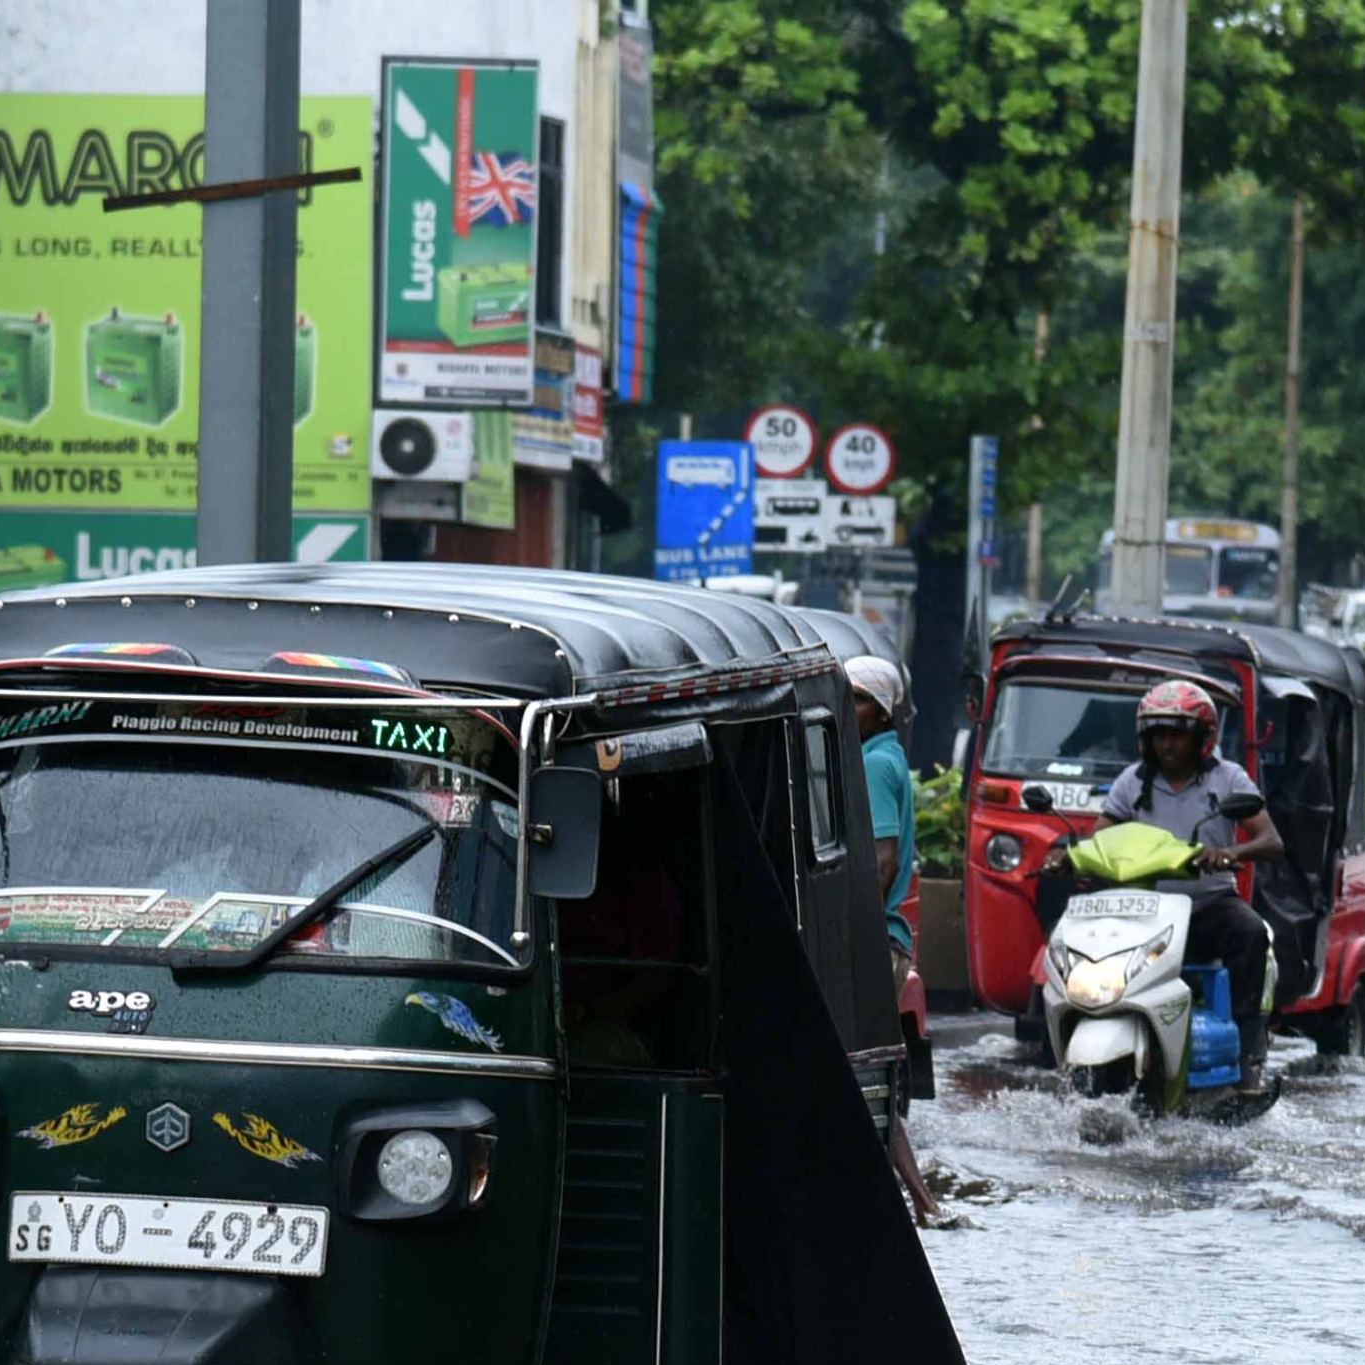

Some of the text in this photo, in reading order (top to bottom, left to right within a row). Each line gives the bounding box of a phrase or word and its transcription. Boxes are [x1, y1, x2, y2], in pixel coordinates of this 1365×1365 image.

[16, 238, 101, 260] LONG,
[112, 238, 202, 257] REALL
[401, 199, 436, 301] Lucas
[766, 418, 796, 437] 50
[846, 436, 876, 453] 40
[12, 468, 123, 493] MOTORS
[76, 532, 198, 580] Luca
[655, 545, 748, 564] BUS LANE
[112, 714, 359, 743] Piaggio Racing Development
[371, 719, 447, 753] TAXI
[69, 990, 150, 1012] ape
[16, 1224, 52, 1251] SG
[63, 1202, 127, 1254] YO
[188, 1210, 319, 1266] 4929
